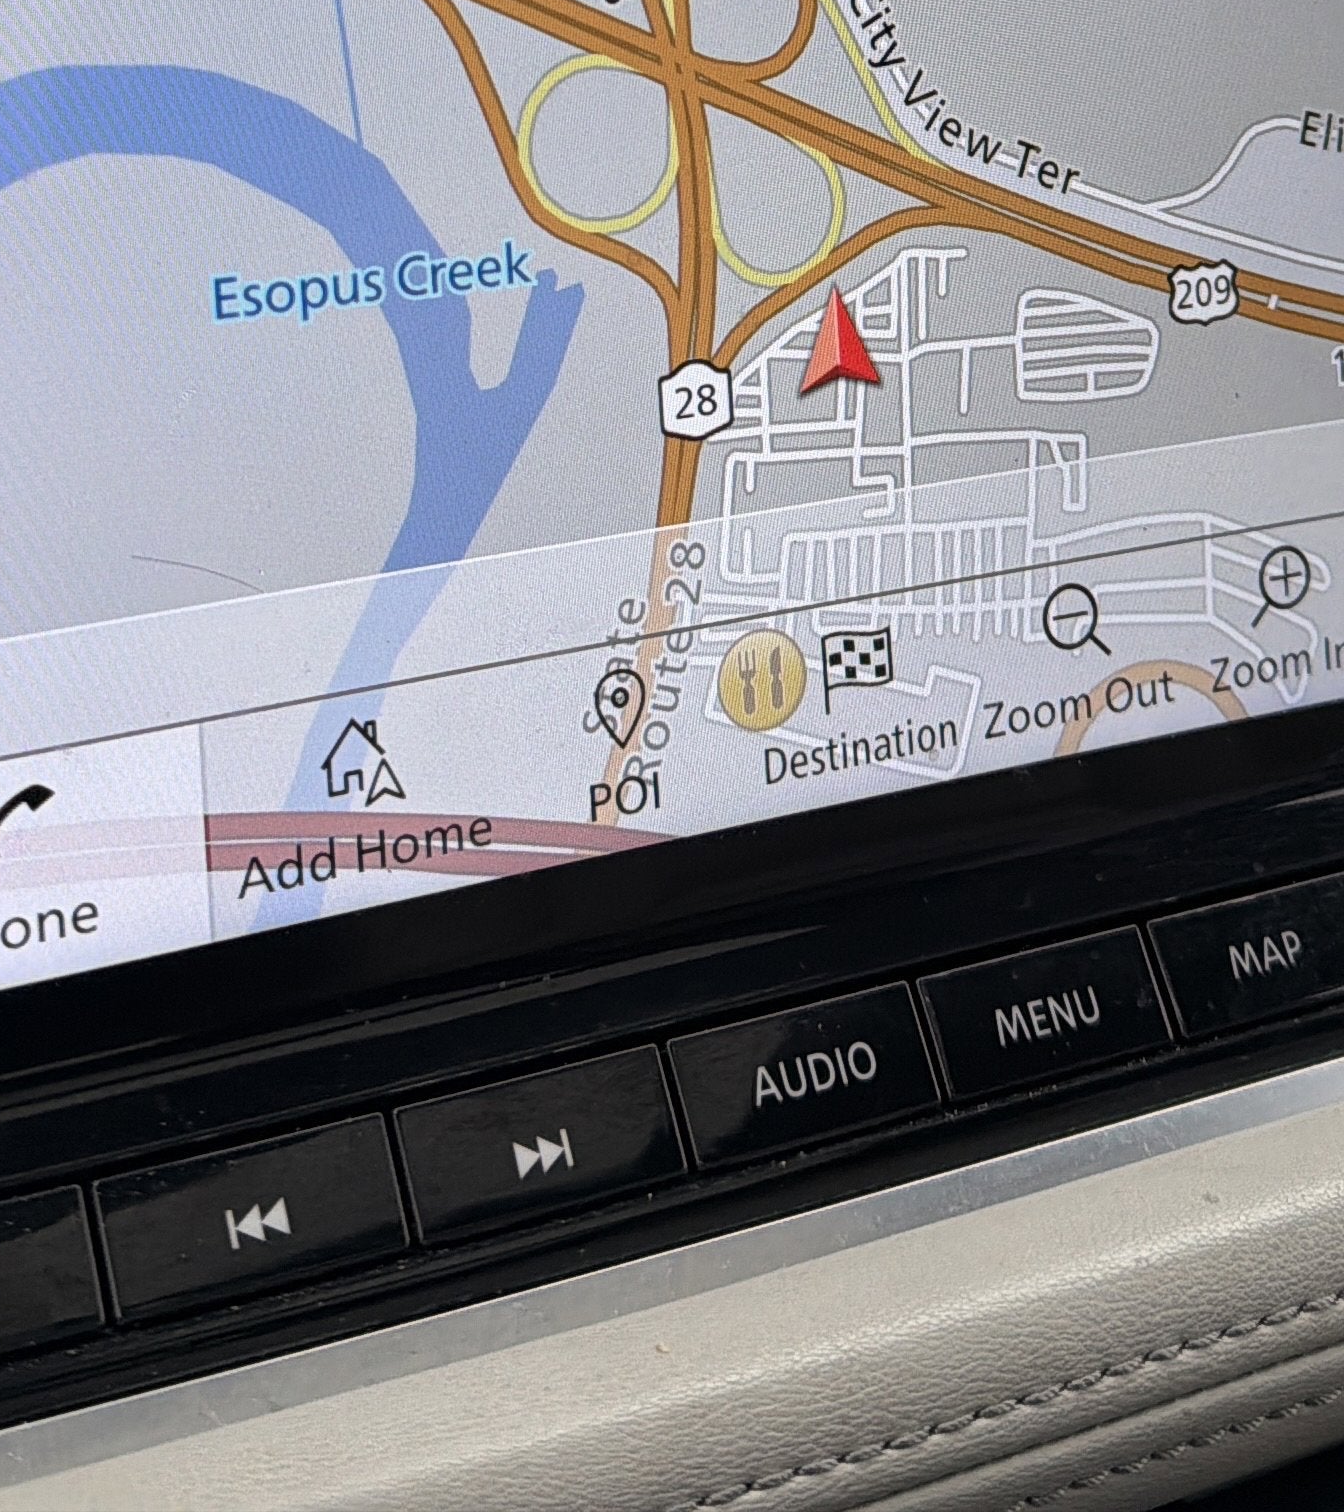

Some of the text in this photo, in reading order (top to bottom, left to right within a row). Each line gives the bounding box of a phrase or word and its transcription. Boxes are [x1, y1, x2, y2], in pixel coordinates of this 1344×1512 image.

[903, 68, 1002, 164] View
[1014, 141, 1080, 194] Ter
[213, 241, 533, 322] Esopus Creek
[1175, 274, 1232, 310] 209
[674, 385, 719, 421] 28
[622, 541, 706, 787] Route 28
[1211, 648, 1311, 692] Zoom
[982, 669, 1175, 739] Zoom Out
[763, 717, 957, 785] Destination
[589, 771, 661, 822] POI
[237, 814, 493, 899] Add Home
[1228, 930, 1303, 982] MAP
[994, 984, 1102, 1049] MENU
[753, 1041, 877, 1111] AUDIO
